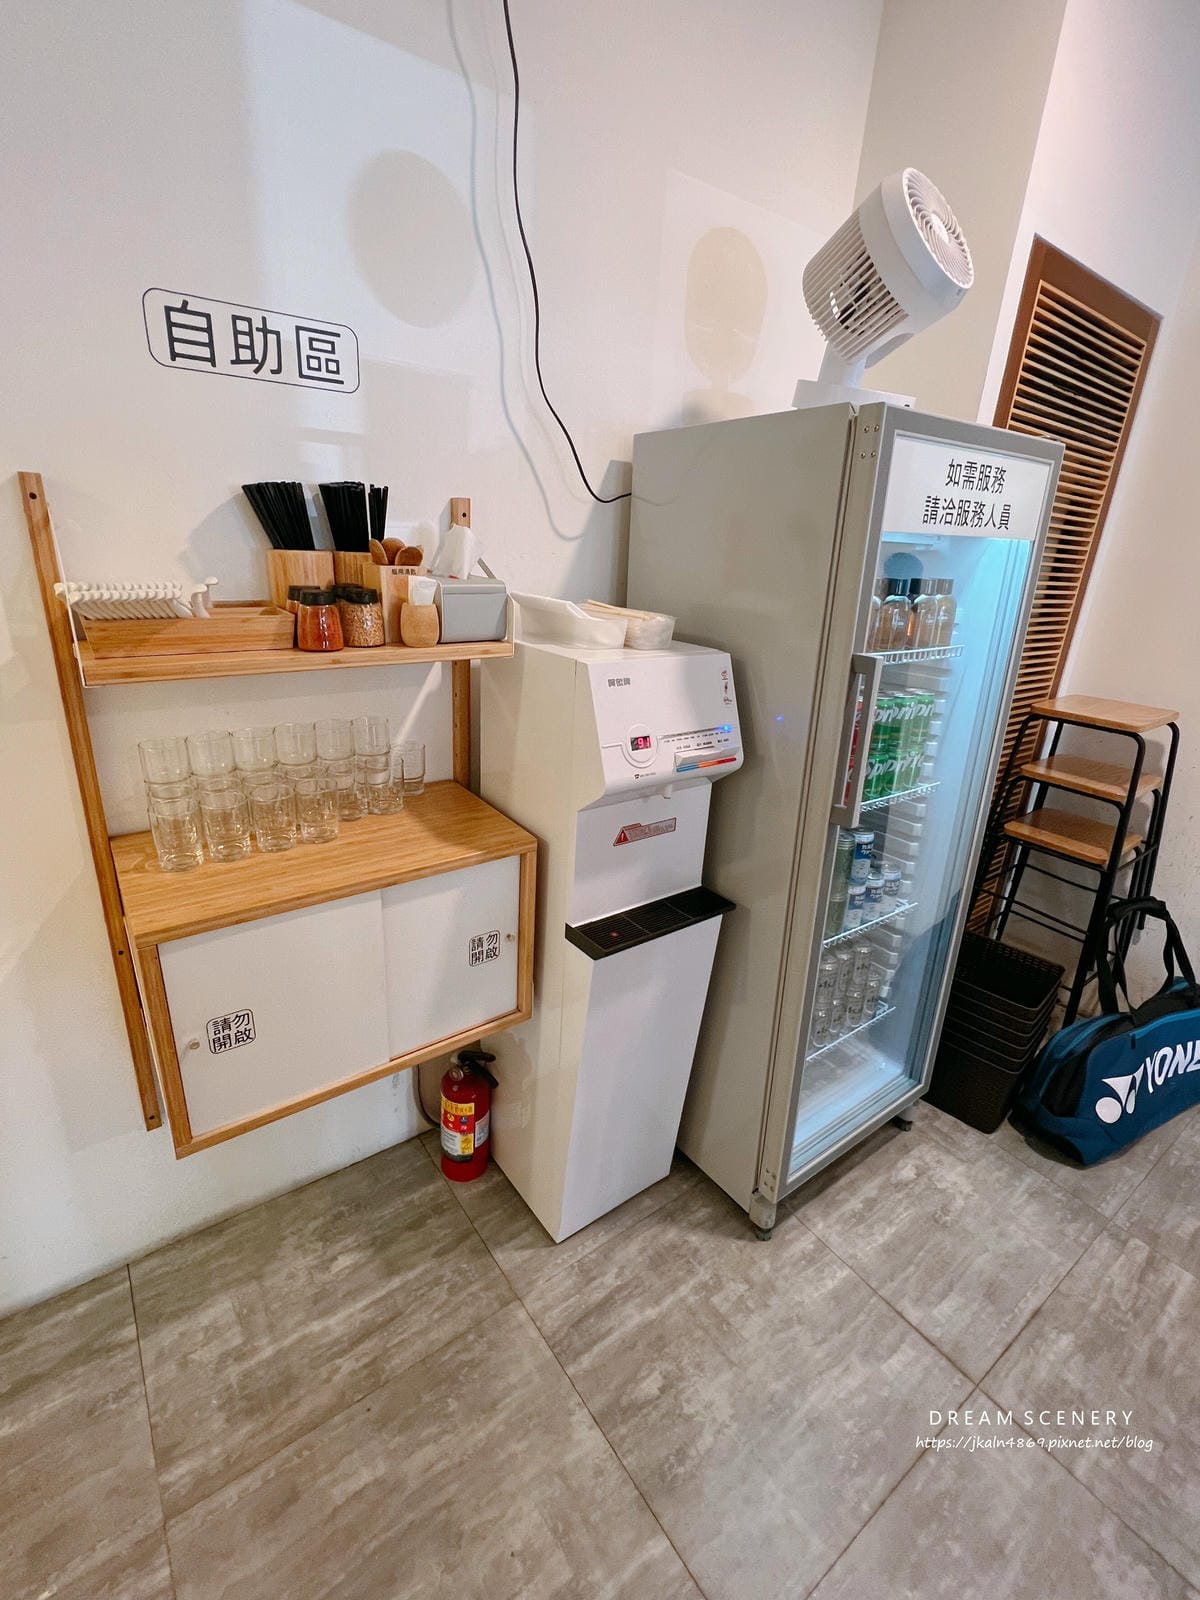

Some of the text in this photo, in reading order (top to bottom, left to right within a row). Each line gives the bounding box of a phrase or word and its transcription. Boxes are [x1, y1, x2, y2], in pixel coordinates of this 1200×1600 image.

[164, 299, 345, 385] 自助區
[945, 459, 1007, 494] 如需服務
[922, 495, 1012, 530] 請洽服務人員
[472, 933, 498, 951] 請勿
[471, 946, 498, 965] 開啟
[211, 1013, 250, 1036] 請勿
[212, 1027, 254, 1052] 開啟
